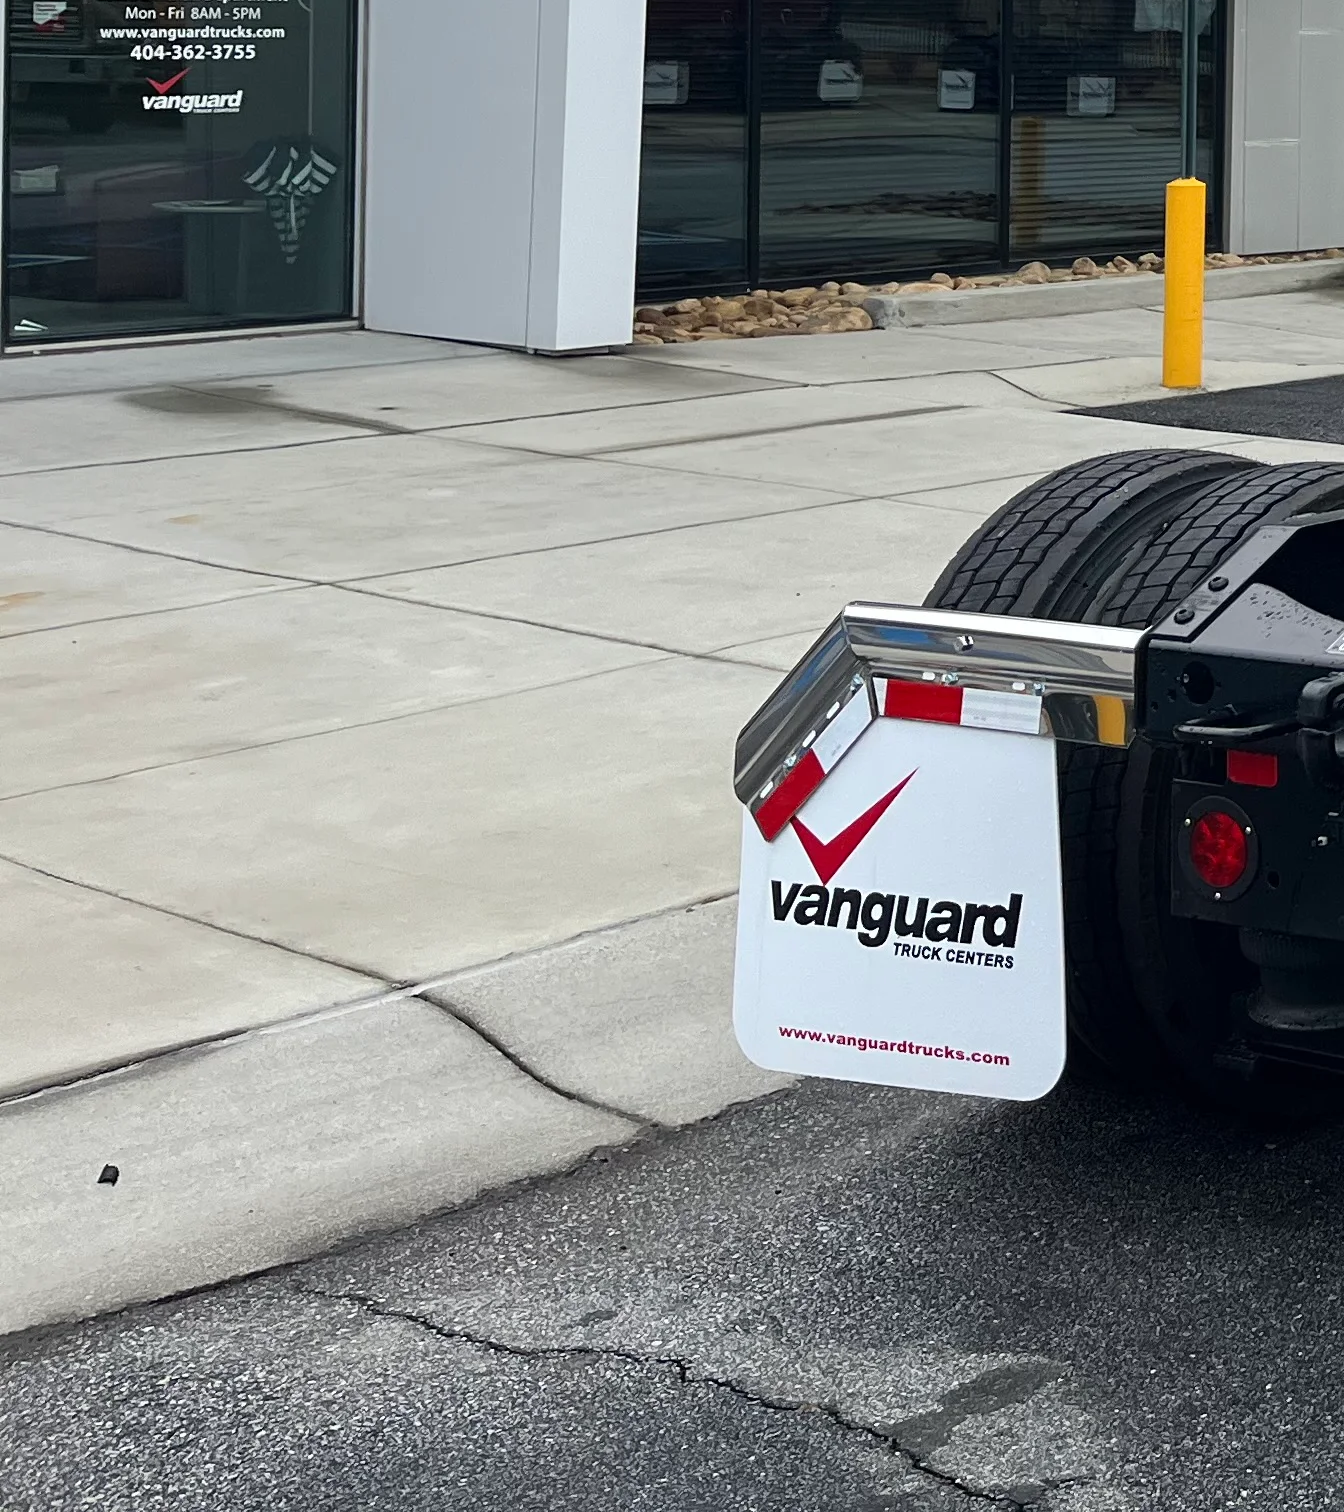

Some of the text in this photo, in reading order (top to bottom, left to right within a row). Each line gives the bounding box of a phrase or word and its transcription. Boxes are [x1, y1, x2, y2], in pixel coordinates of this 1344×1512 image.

[125, 6, 157, 19] Mon
[168, 6, 185, 19] Fri
[190, 7, 222, 20] 8AM
[232, 7, 261, 20] 5PM
[100, 25, 285, 41] www.vanguardtrucks.com
[130, 44, 256, 60] 404-362-3755
[142, 90, 243, 113] vanguard
[770, 879, 1023, 949] vanguard
[893, 941, 1015, 970] TRUCK CENTERS
[779, 1026, 1010, 1067] www.vanguardtrucks.com
